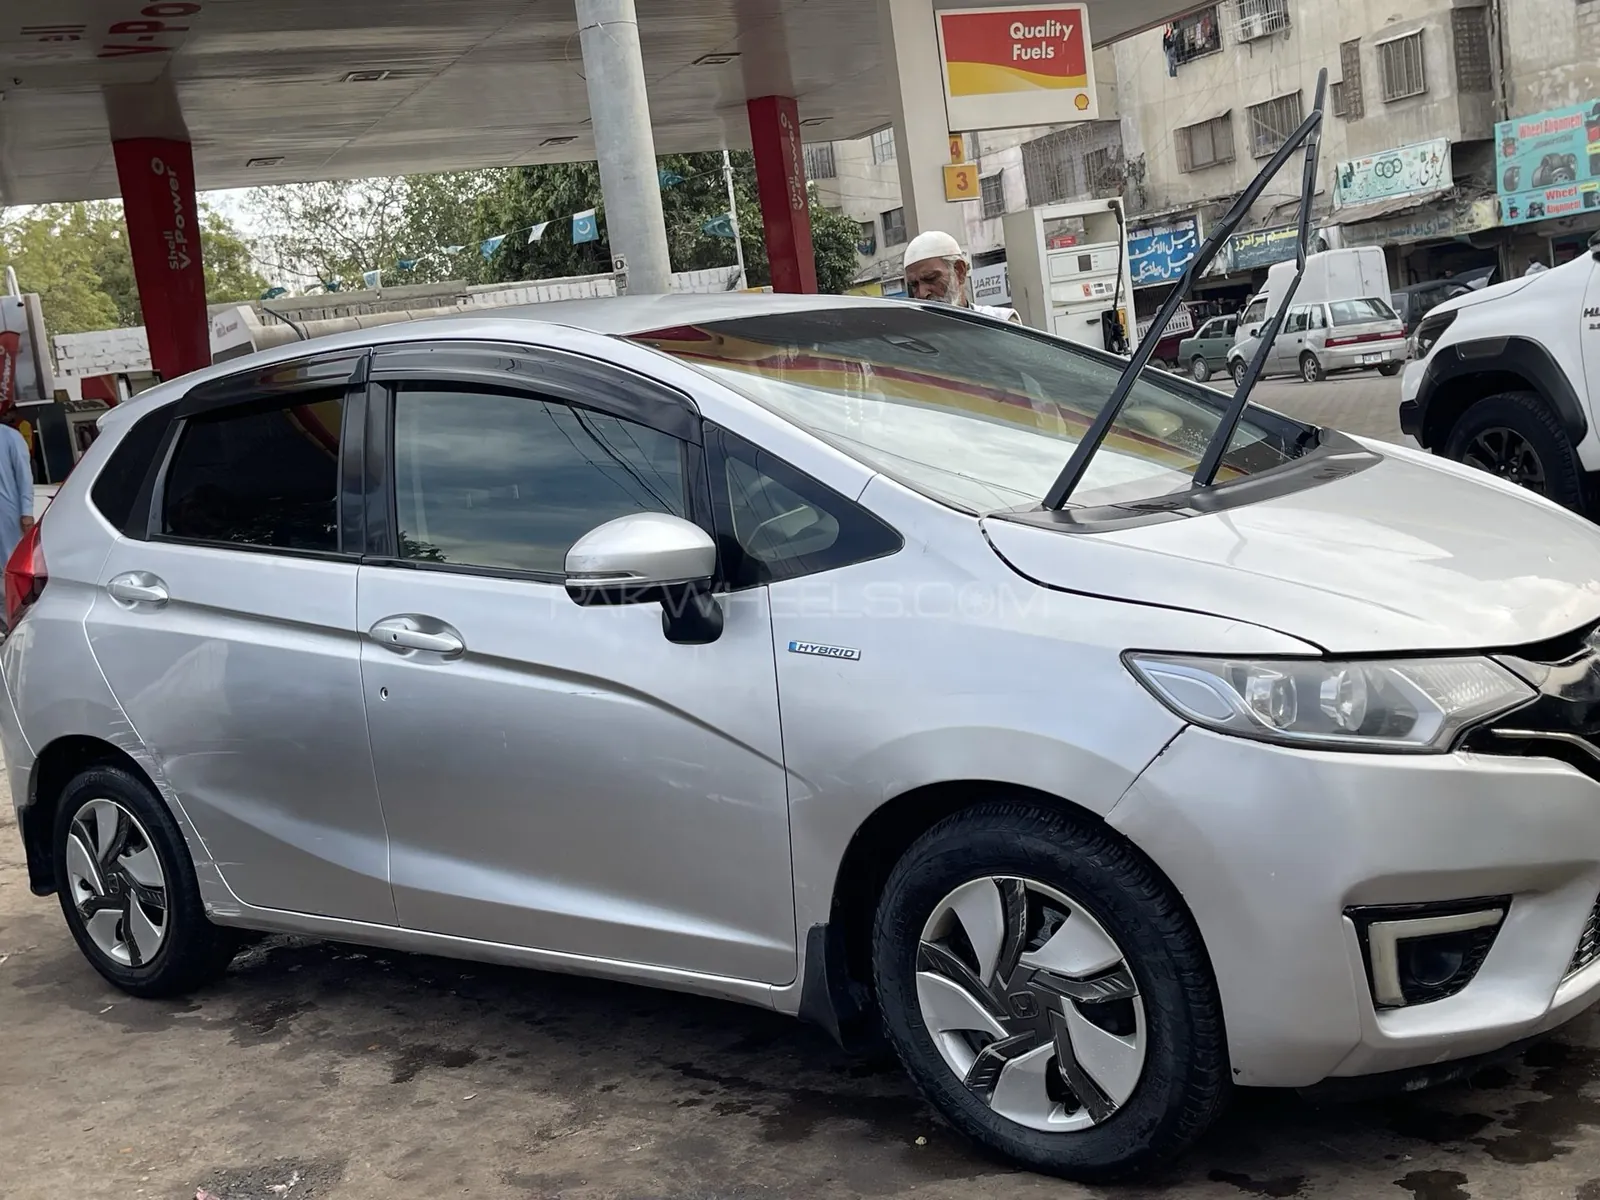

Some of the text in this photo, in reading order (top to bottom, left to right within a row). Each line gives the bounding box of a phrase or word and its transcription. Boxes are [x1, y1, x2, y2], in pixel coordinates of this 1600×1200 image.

[1010, 20, 1074, 41] Quality
[1013, 41, 1055, 60] Fuels
[1519, 121, 1544, 138] Wheel
[950, 141, 961, 157] 4
[788, 121, 804, 210] V-Power
[956, 172, 968, 191] 3
[1545, 187, 1577, 201] Wheel
[166, 165, 192, 269] V-Power
[163, 230, 179, 269] Shell
[798, 644, 855, 658] HYBRID
